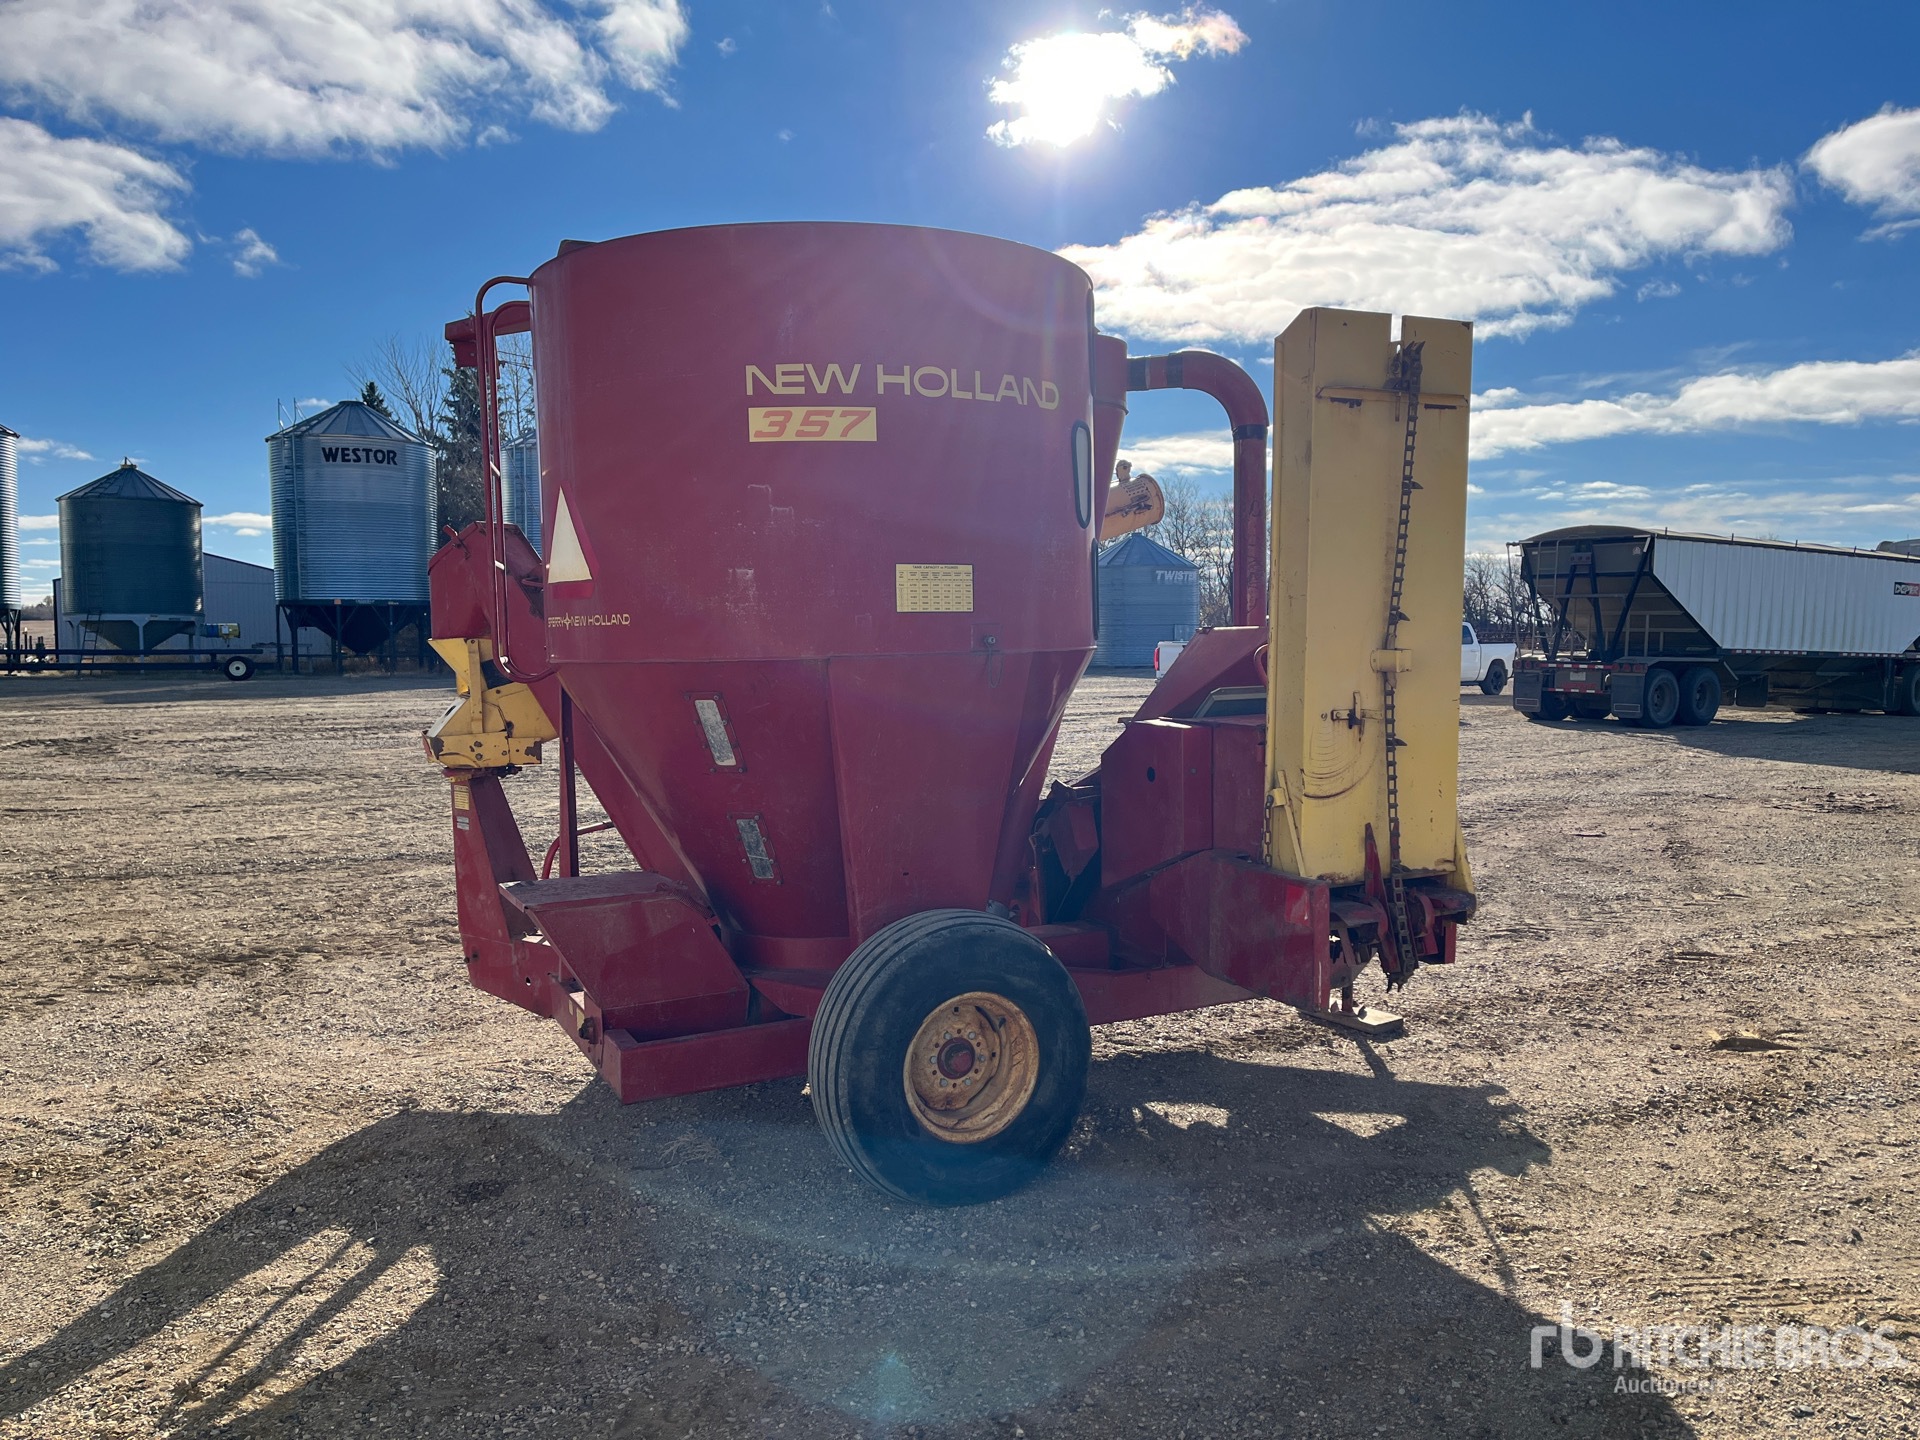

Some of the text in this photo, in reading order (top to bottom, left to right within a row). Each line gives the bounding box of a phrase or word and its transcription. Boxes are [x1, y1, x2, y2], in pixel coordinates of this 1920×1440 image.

[745, 363, 1060, 411] NEW HOLLAND
[753, 409, 872, 439] 357
[321, 446, 398, 466] WESTOR
[571, 615, 587, 627] NEW
[587, 613, 631, 626] HOLLAND
